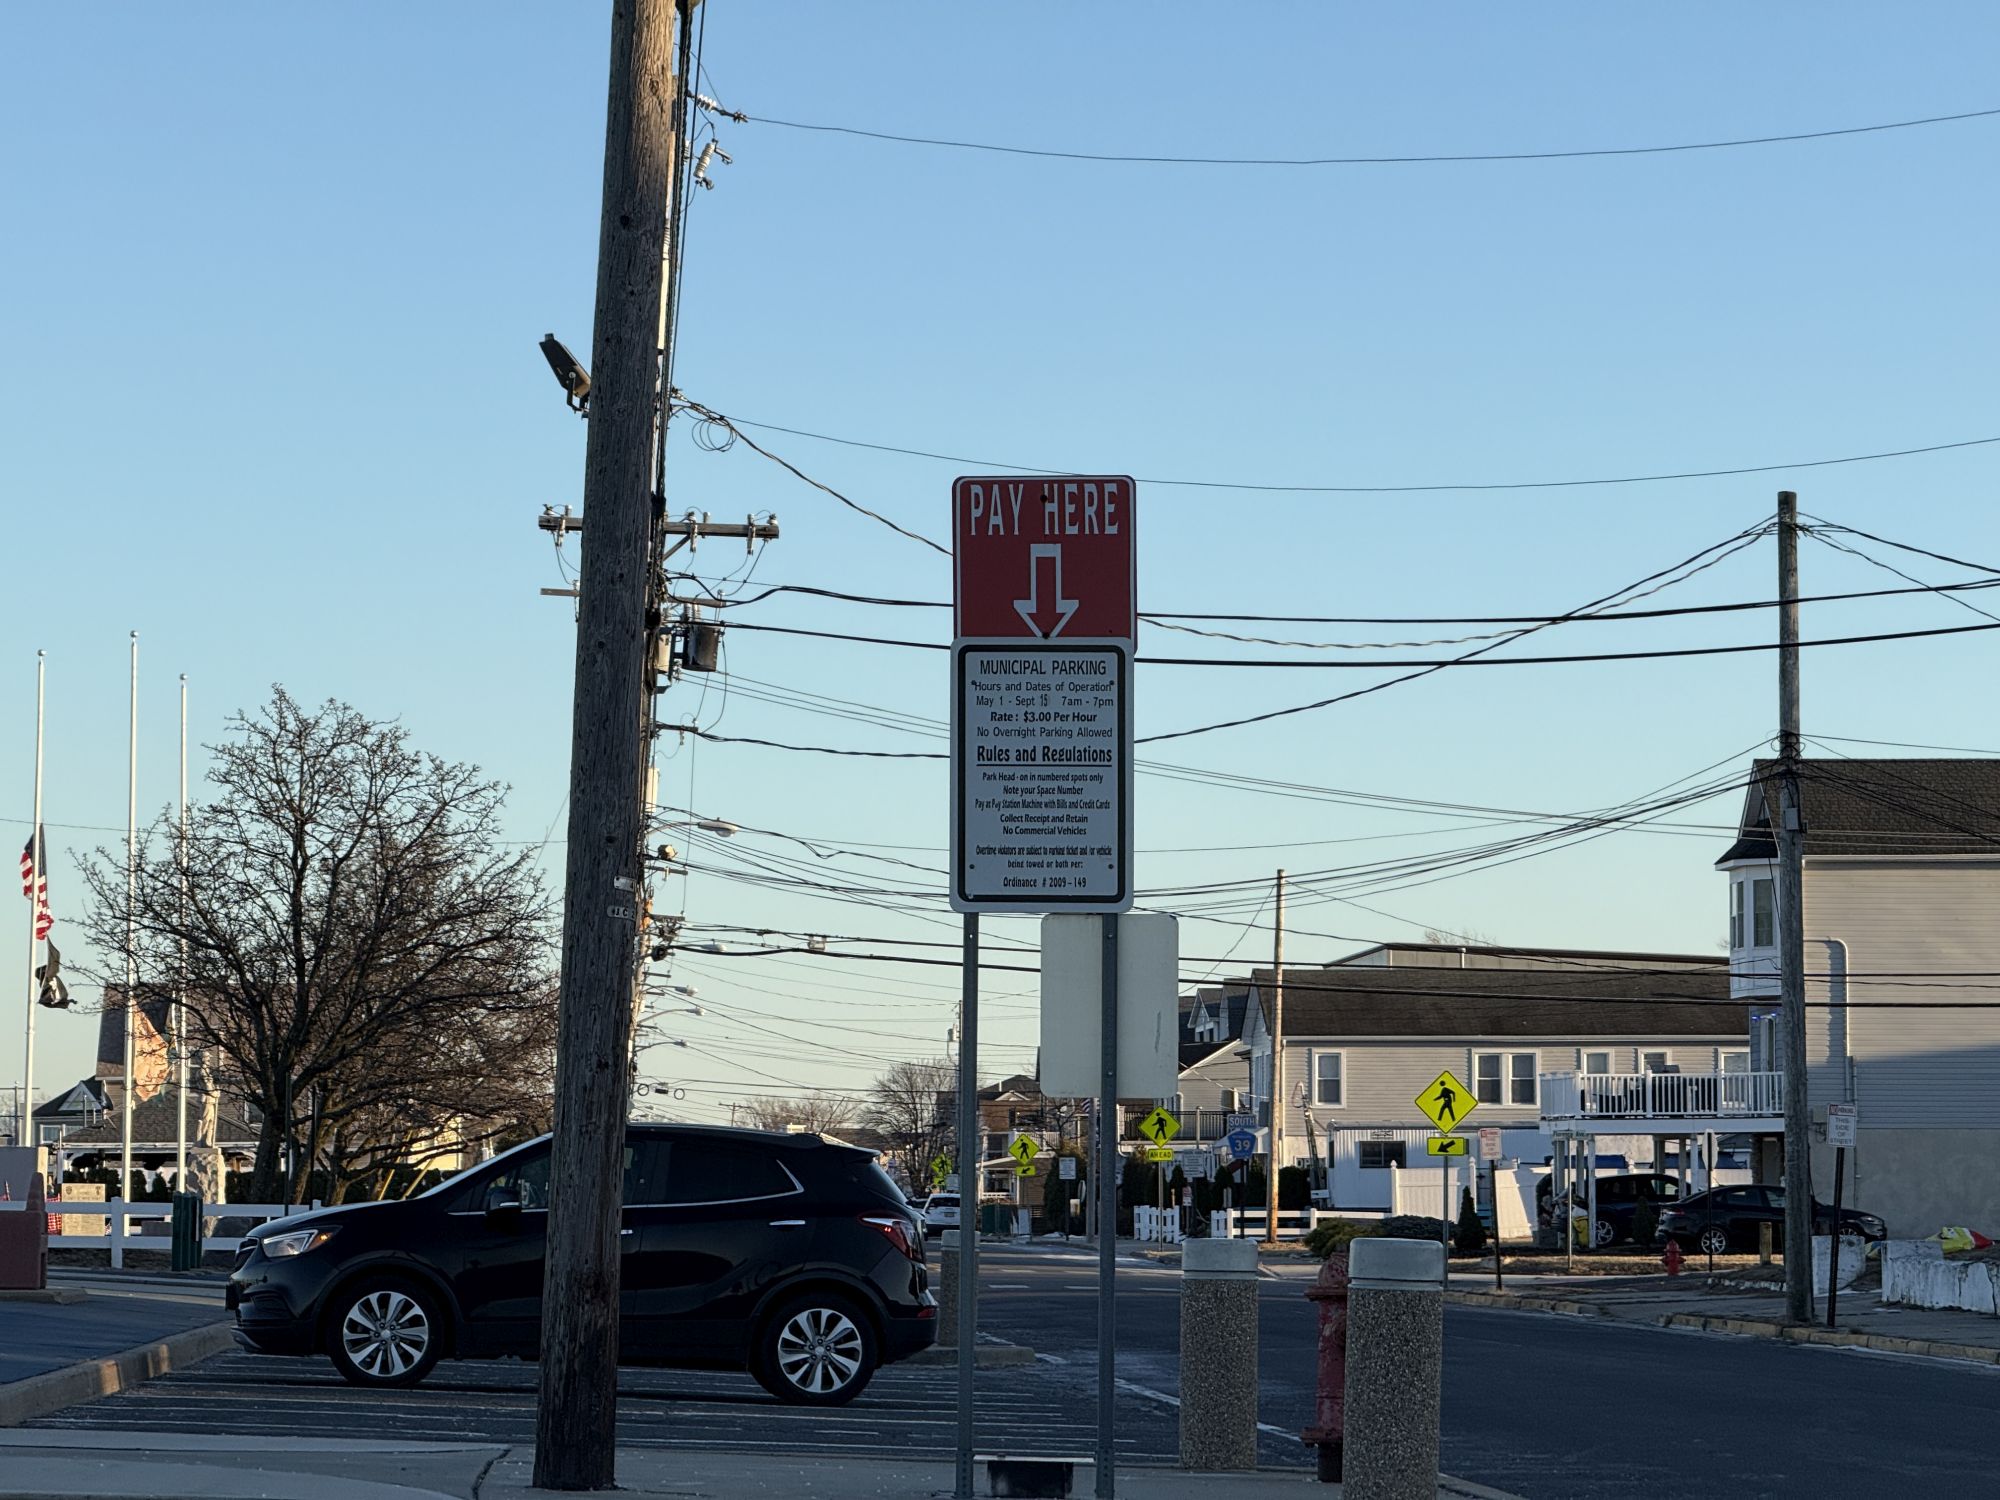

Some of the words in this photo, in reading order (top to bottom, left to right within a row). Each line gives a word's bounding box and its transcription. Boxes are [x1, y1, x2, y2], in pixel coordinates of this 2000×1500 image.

[970, 483, 1024, 536] PAY
[1043, 483, 1119, 535] HERE
[980, 660, 1046, 675] MUNICIPAL
[1052, 660, 1106, 675] PARKING
[974, 682, 1001, 691] Hours
[1005, 682, 1021, 691] and
[1026, 682, 1051, 691] Dates
[1055, 682, 1064, 691] of
[1069, 682, 1111, 693] Operation
[976, 696, 994, 707] May
[1016, 696, 1035, 707] Sept
[1062, 696, 1082, 706] 7am
[1094, 697, 1113, 708] 7pm
[1024, 711, 1051, 723] $3.00
[1054, 712, 1070, 722] Per
[1072, 712, 1097, 722] Hour
[977, 727, 989, 736] No
[993, 727, 1036, 738] Overnight
[1040, 727, 1072, 739] Parking
[1077, 727, 1112, 737] Allowed
[977, 745, 1010, 762] Rules
[1016, 746, 1036, 762] and
[1042, 745, 1112, 762] Regulations
[983, 772, 997, 781] Park
[1030, 773, 1036, 781] in
[1037, 773, 1069, 781] numbered
[1071, 774, 1087, 784] spots
[1089, 773, 1103, 784] only
[1003, 785, 1019, 794] Note
[1020, 787, 1035, 797] your
[1037, 785, 1055, 797] Space
[1057, 785, 1083, 794] Number
[975, 799, 984, 811] Pay
[992, 799, 1001, 811] Pay
[1002, 799, 1020, 808] Station
[1022, 799, 1042, 808] Machine
[1044, 799, 1056, 808] with
[1068, 800, 1078, 808] and
[1079, 800, 1094, 809] Credit
[1096, 800, 1110, 809] Cards
[1000, 814, 1023, 822] Collect
[1025, 814, 1050, 825] Receipt
[1051, 814, 1064, 822] and
[1066, 814, 1088, 823] Retain
[1003, 826, 1013, 834] No
[1015, 826, 1056, 835] Commercial
[1057, 826, 1086, 835] Vehicles
[1043, 847, 1047, 855] to
[1026, 860, 1044, 868] towed
[1055, 860, 1068, 868] both
[1003, 877, 1037, 887] Ordinance
[1043, 878, 1046, 887] #
[1229, 1117, 1255, 1126] SOUTH
[1235, 1139, 1250, 1151] 39
